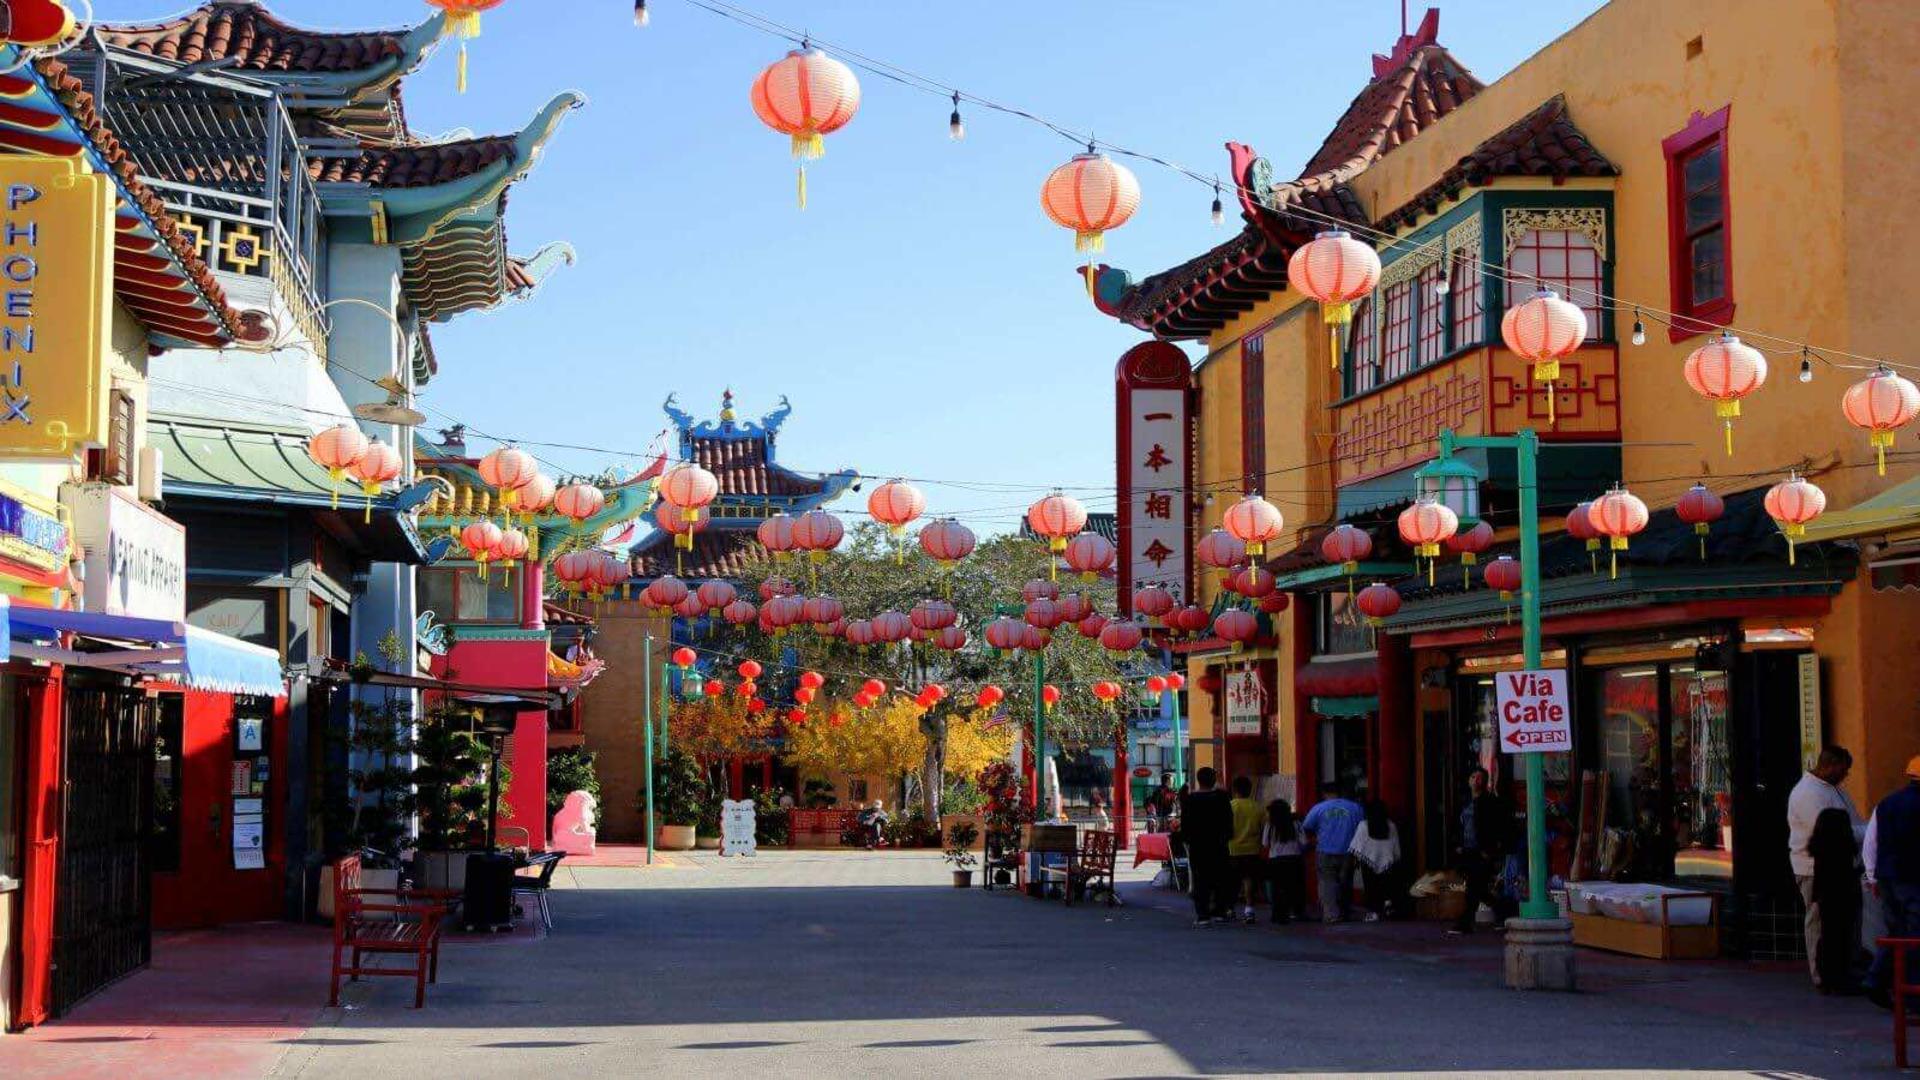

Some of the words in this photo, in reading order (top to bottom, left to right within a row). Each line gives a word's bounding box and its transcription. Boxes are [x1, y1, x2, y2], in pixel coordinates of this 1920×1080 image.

[1, 183, 40, 425] PHOENIX
[1509, 674, 1554, 697] Via
[1504, 700, 1563, 724] Cafe
[244, 725, 257, 740] A
[1516, 731, 1566, 744] OPEN
